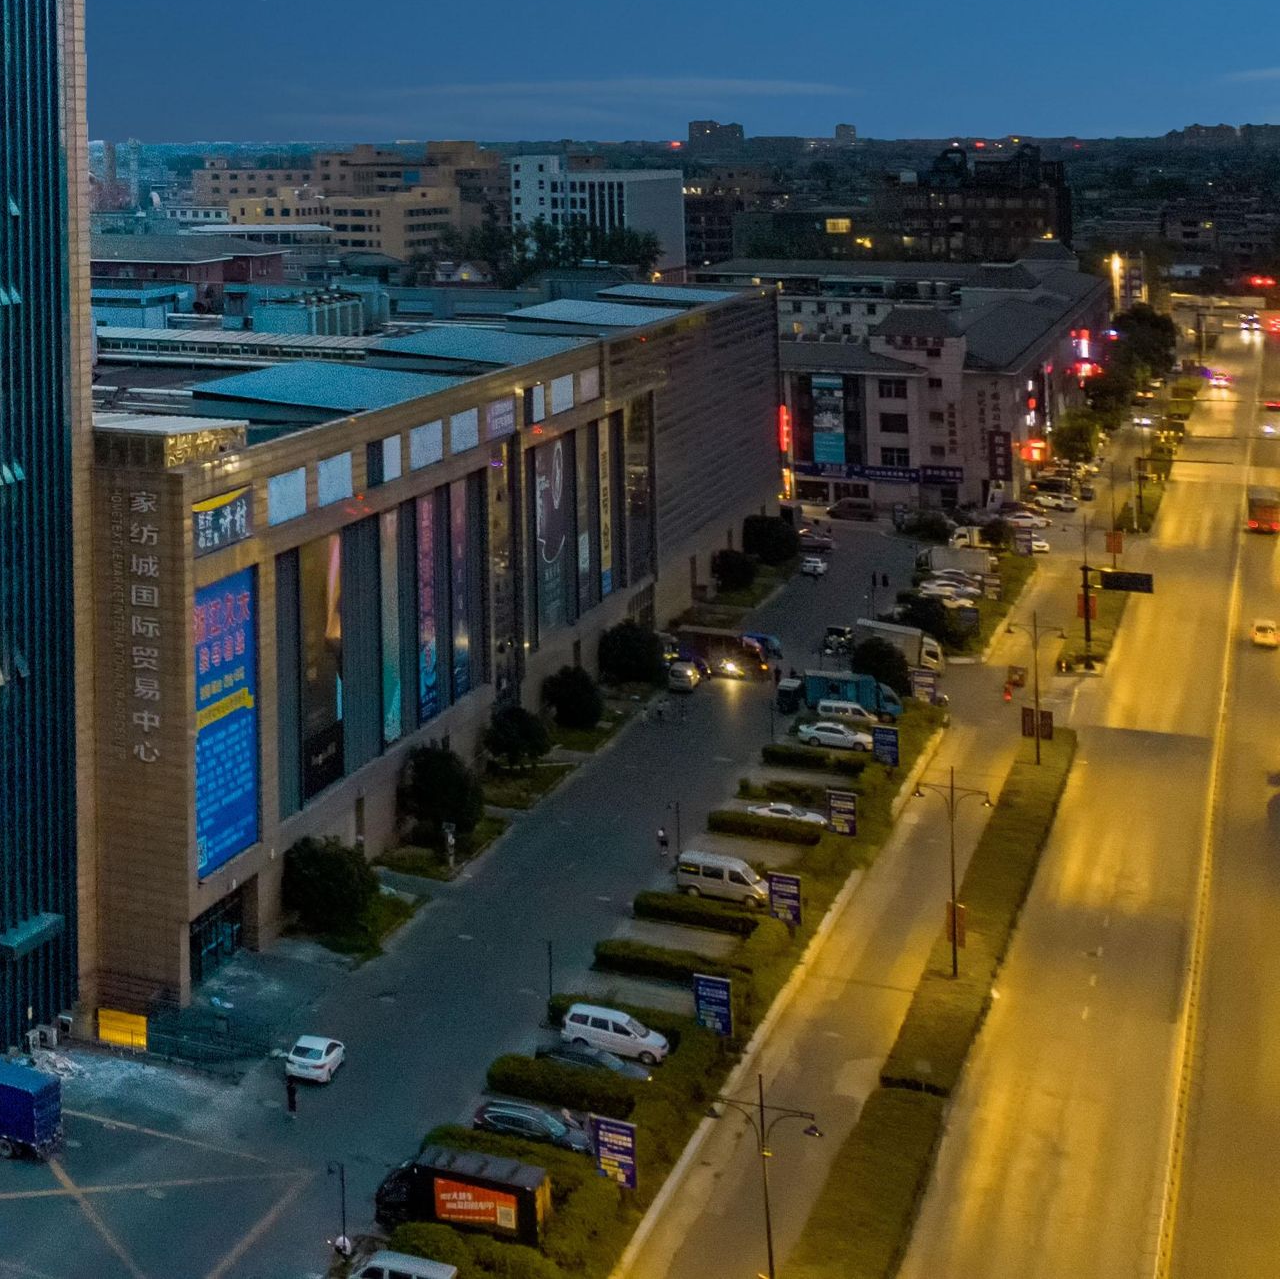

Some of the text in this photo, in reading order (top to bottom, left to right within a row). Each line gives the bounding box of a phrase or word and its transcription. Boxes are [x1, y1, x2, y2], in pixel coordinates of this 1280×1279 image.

[129, 490, 161, 763] 家纺城国际贸易中心
